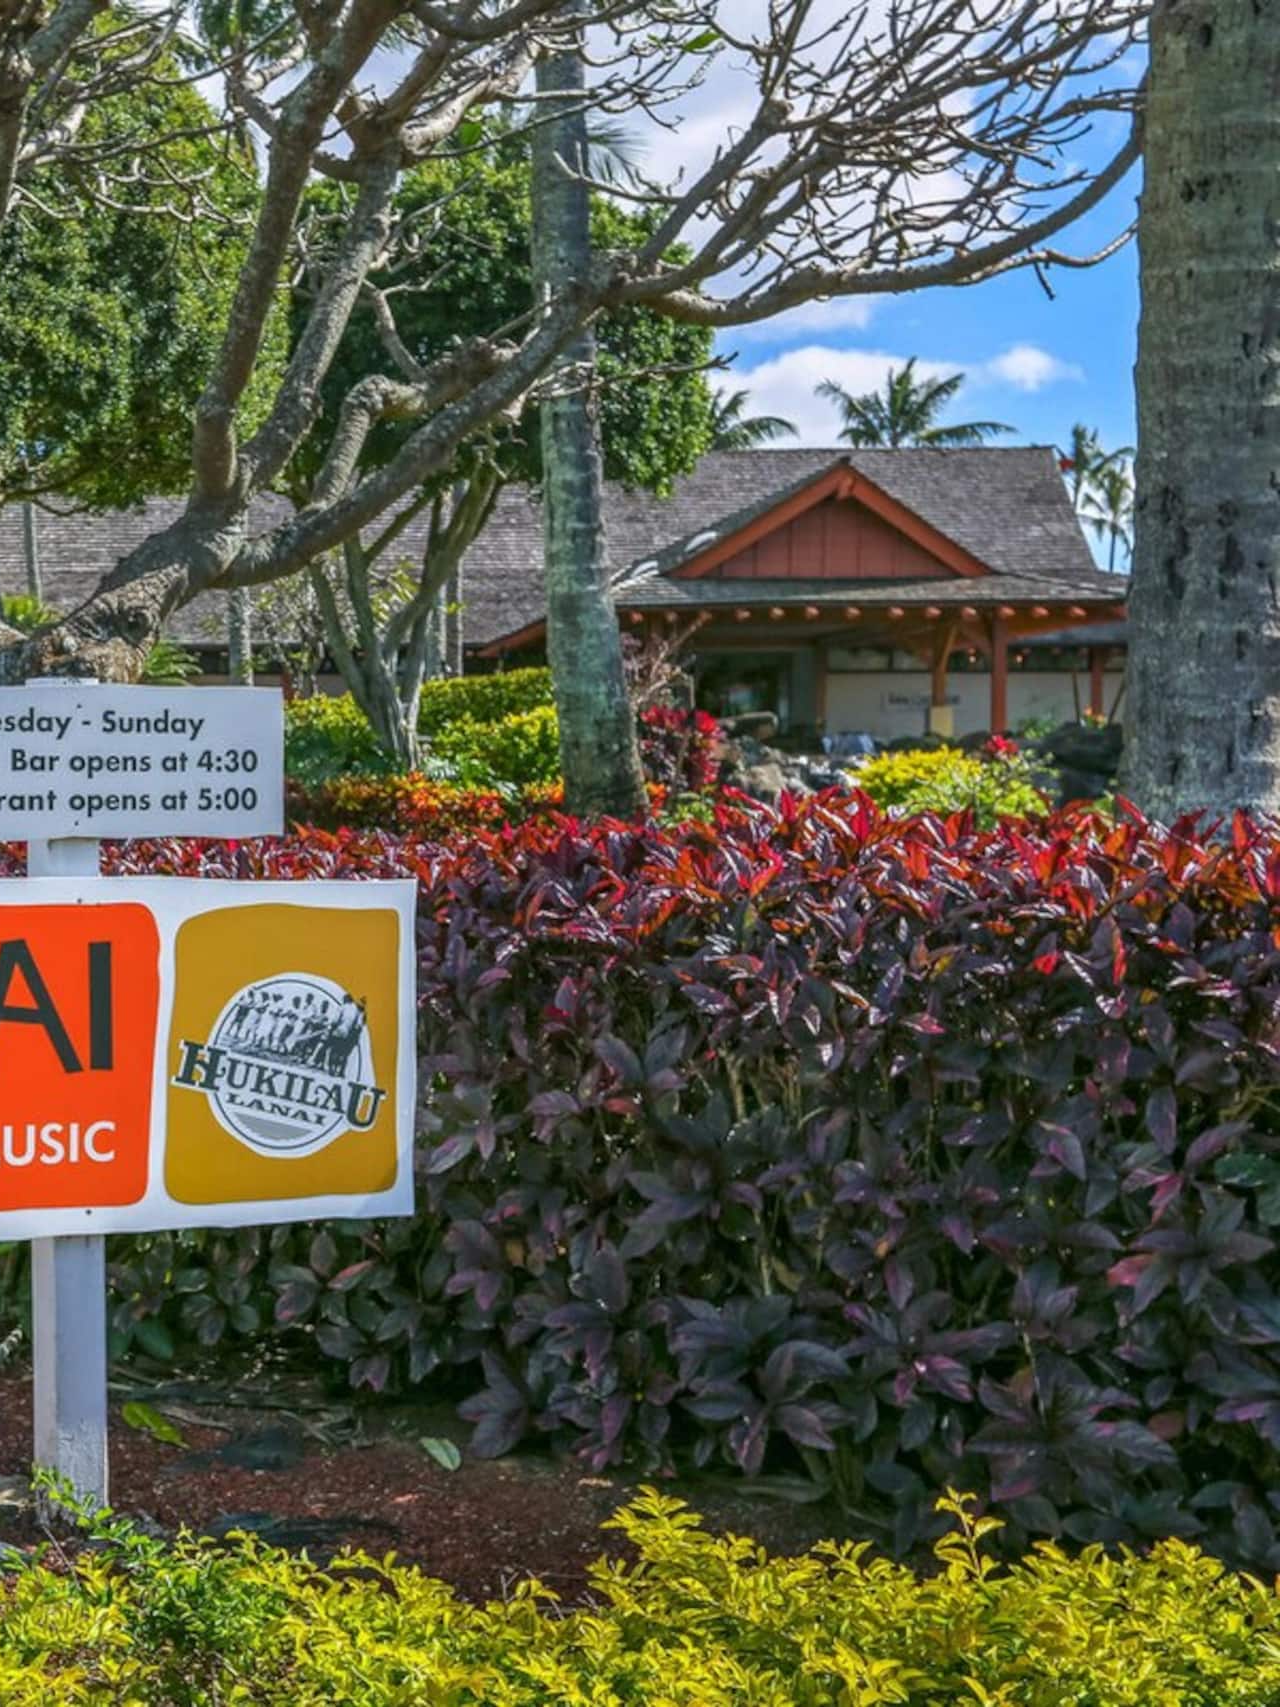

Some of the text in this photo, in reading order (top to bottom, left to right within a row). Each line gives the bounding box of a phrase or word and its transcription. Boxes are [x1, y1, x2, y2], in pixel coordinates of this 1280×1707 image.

[101, 708, 205, 742] Sunday
[10, 748, 61, 773] Bar
[68, 755, 152, 780] opens
[160, 751, 189, 773] at
[196, 748, 259, 774] 4:30
[68, 793, 152, 819] opens
[160, 789, 189, 812] at
[197, 786, 259, 812] 5:00
[174, 1040, 386, 1129] HUKILAU
[226, 1092, 327, 1127] LANAI
